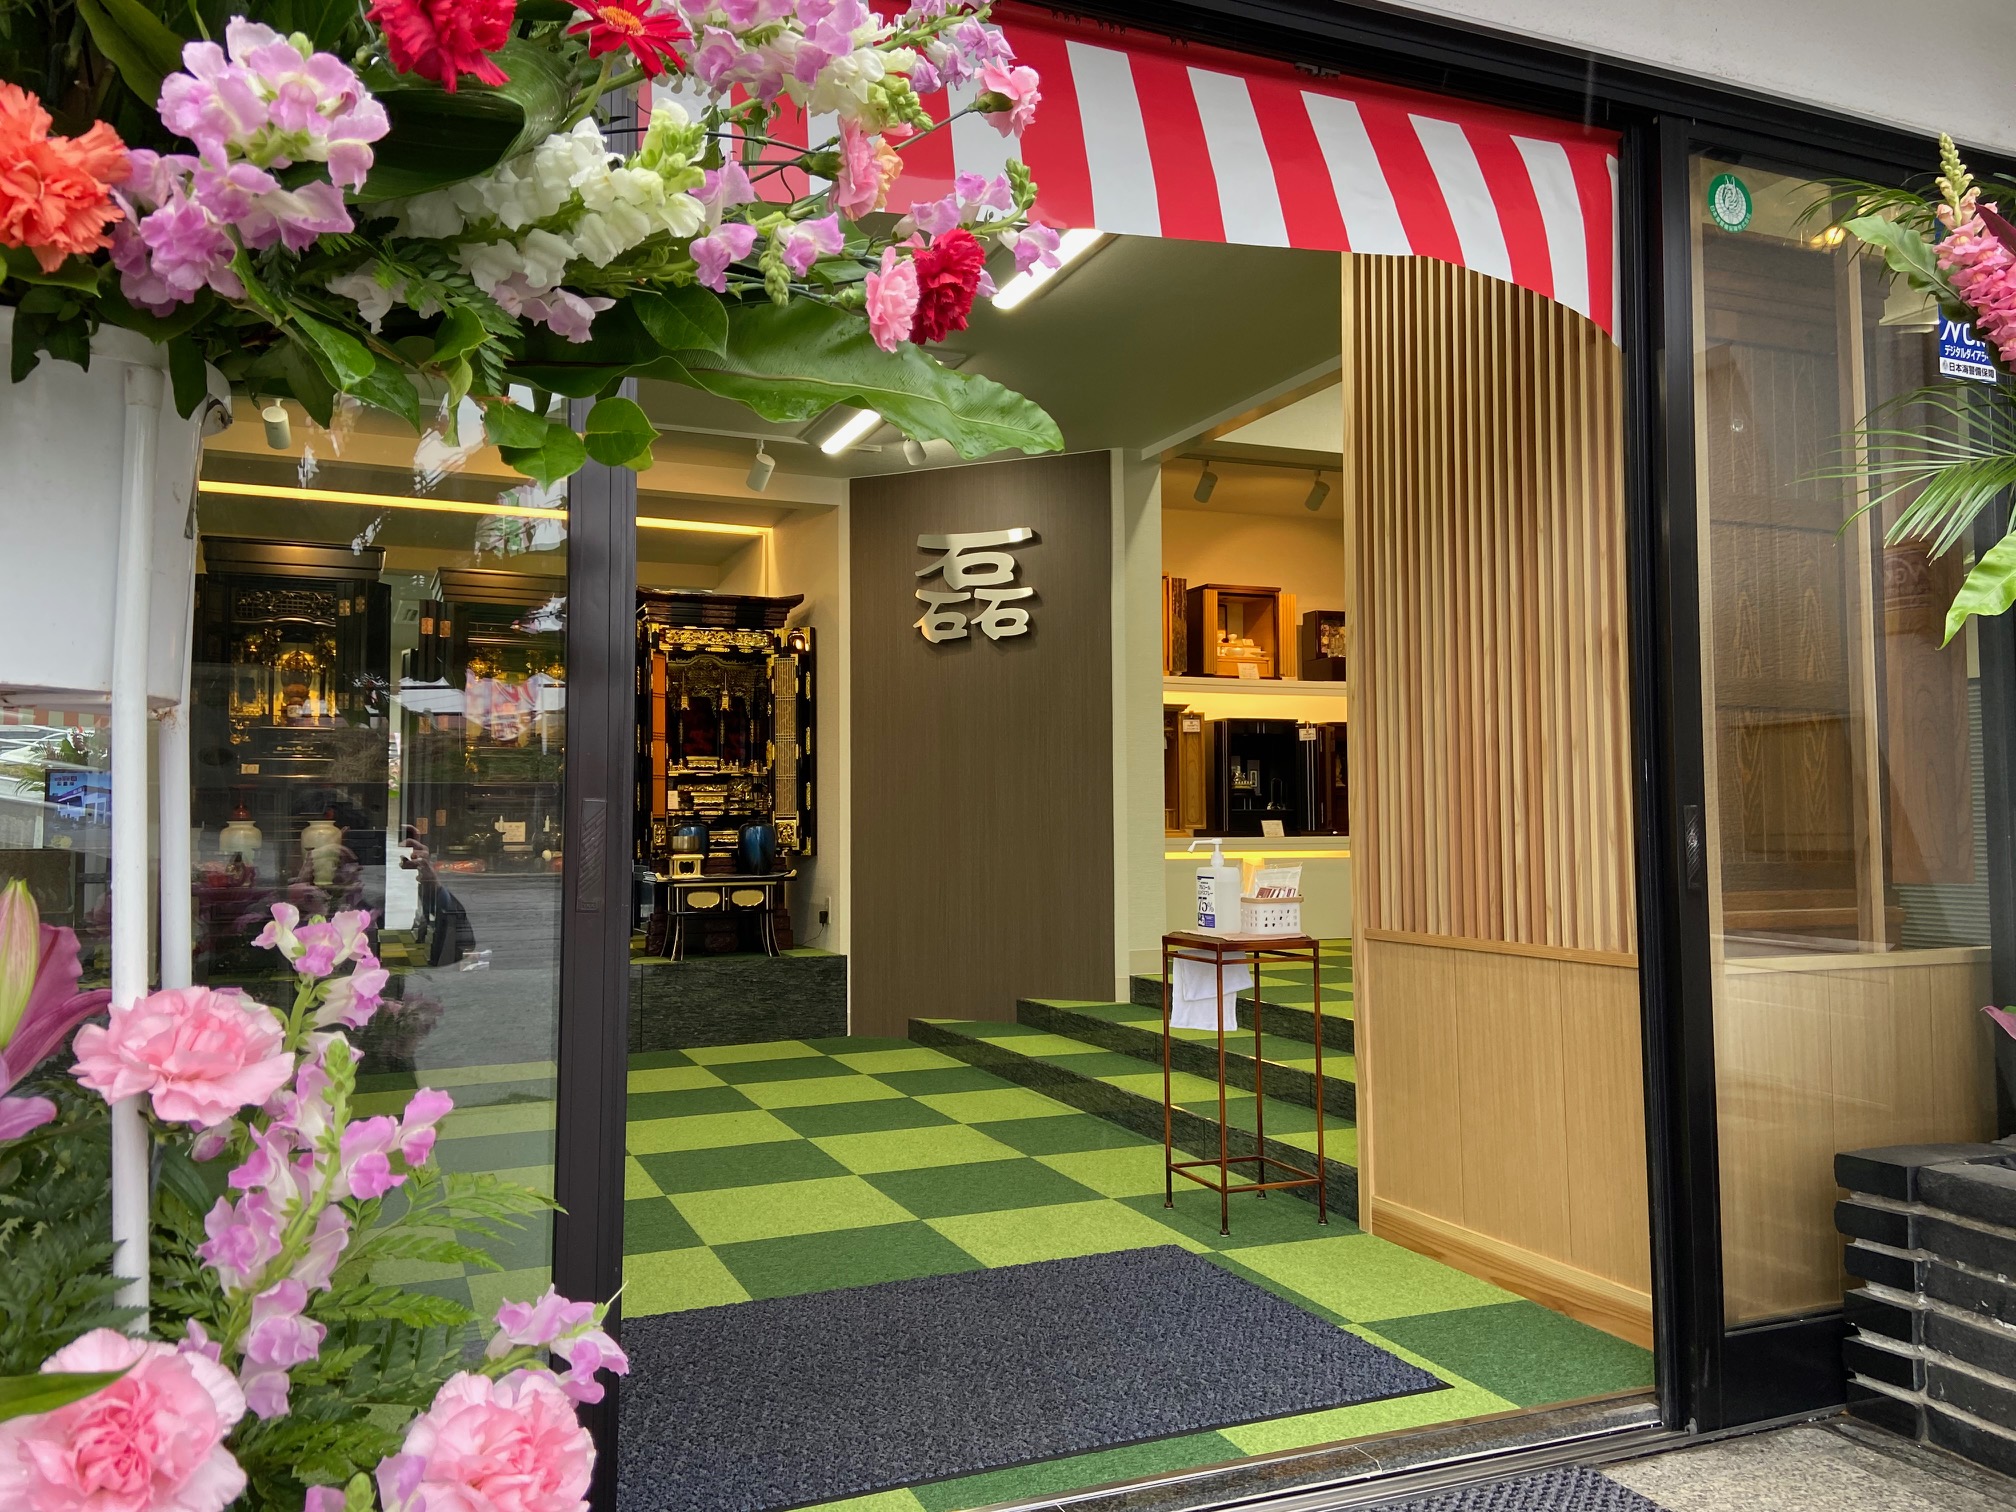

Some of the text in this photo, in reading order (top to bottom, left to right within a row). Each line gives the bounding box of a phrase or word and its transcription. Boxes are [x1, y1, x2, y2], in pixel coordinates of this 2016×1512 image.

[1944, 345, 1989, 362] デジタルダイアラ
